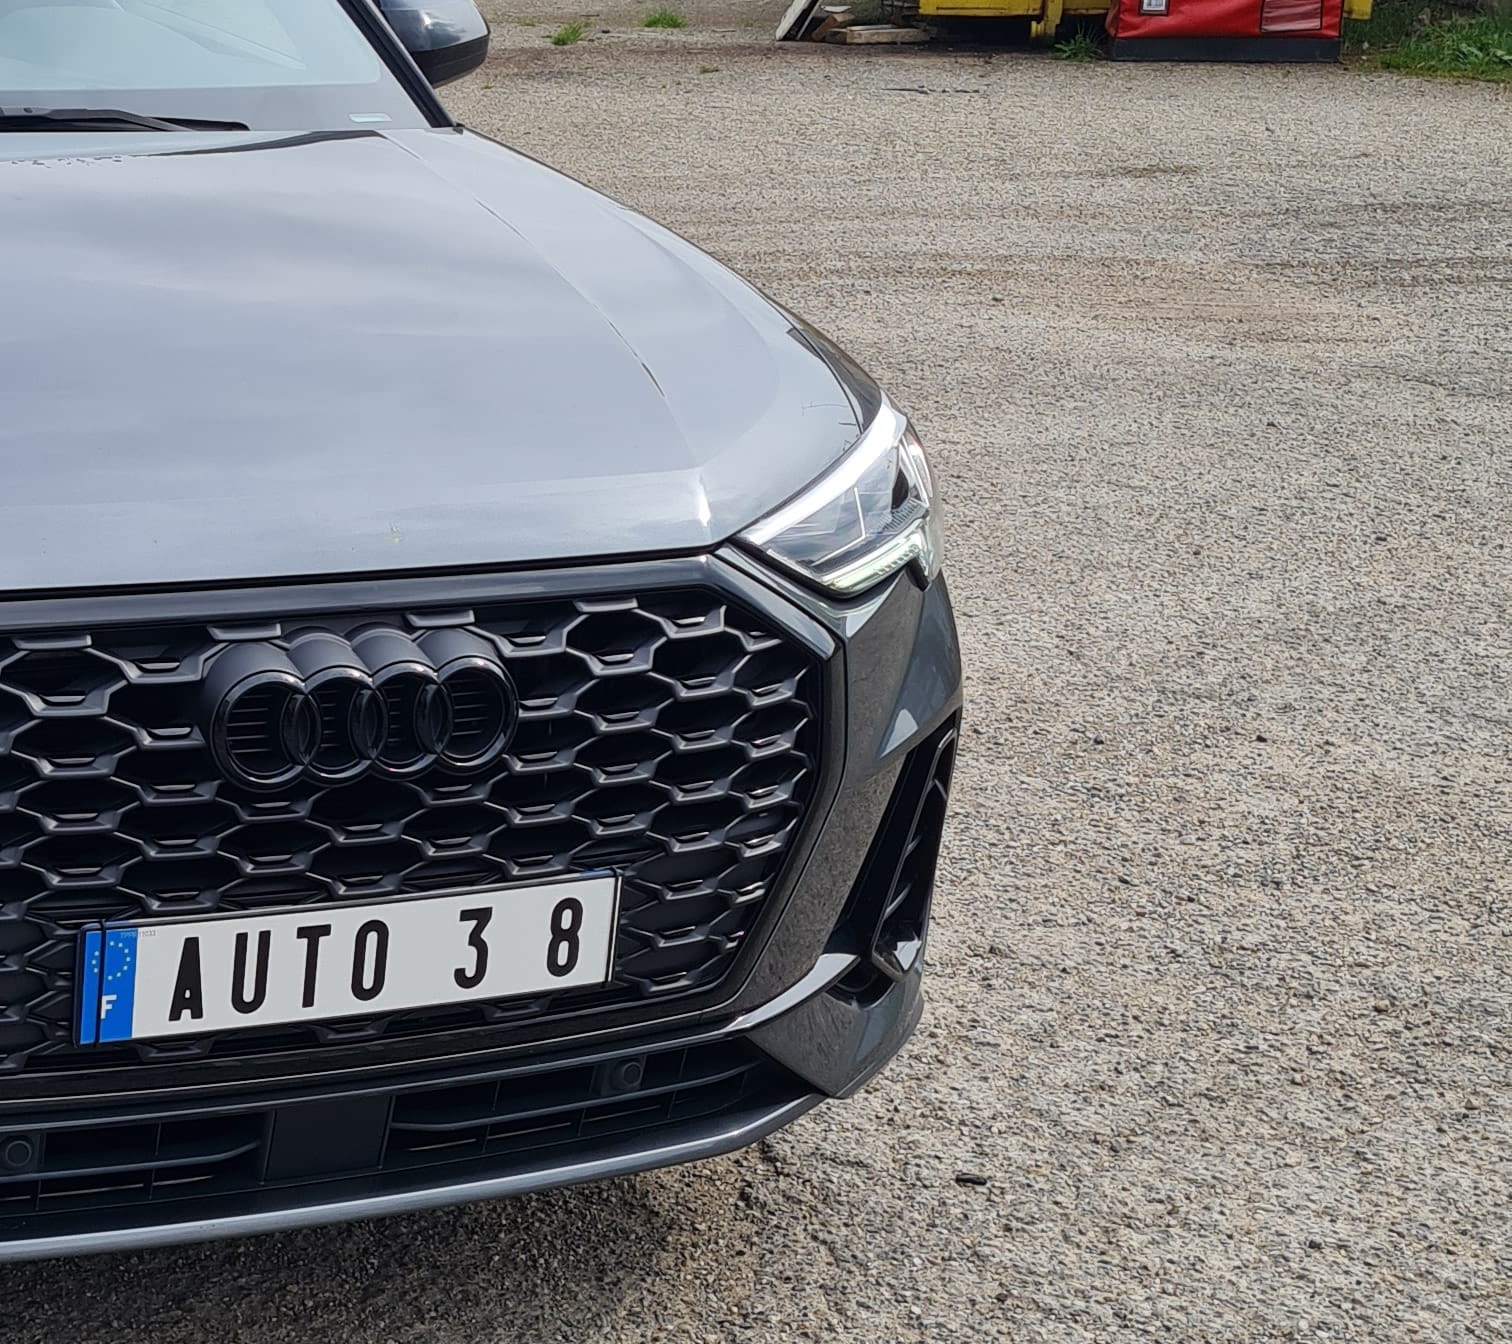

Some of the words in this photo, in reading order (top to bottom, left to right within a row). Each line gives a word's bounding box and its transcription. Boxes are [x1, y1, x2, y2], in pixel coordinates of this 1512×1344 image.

[168, 920, 389, 1022] AUTO
[453, 906, 493, 990] 3
[546, 897, 584, 978] 8
[100, 994, 117, 1019] F
